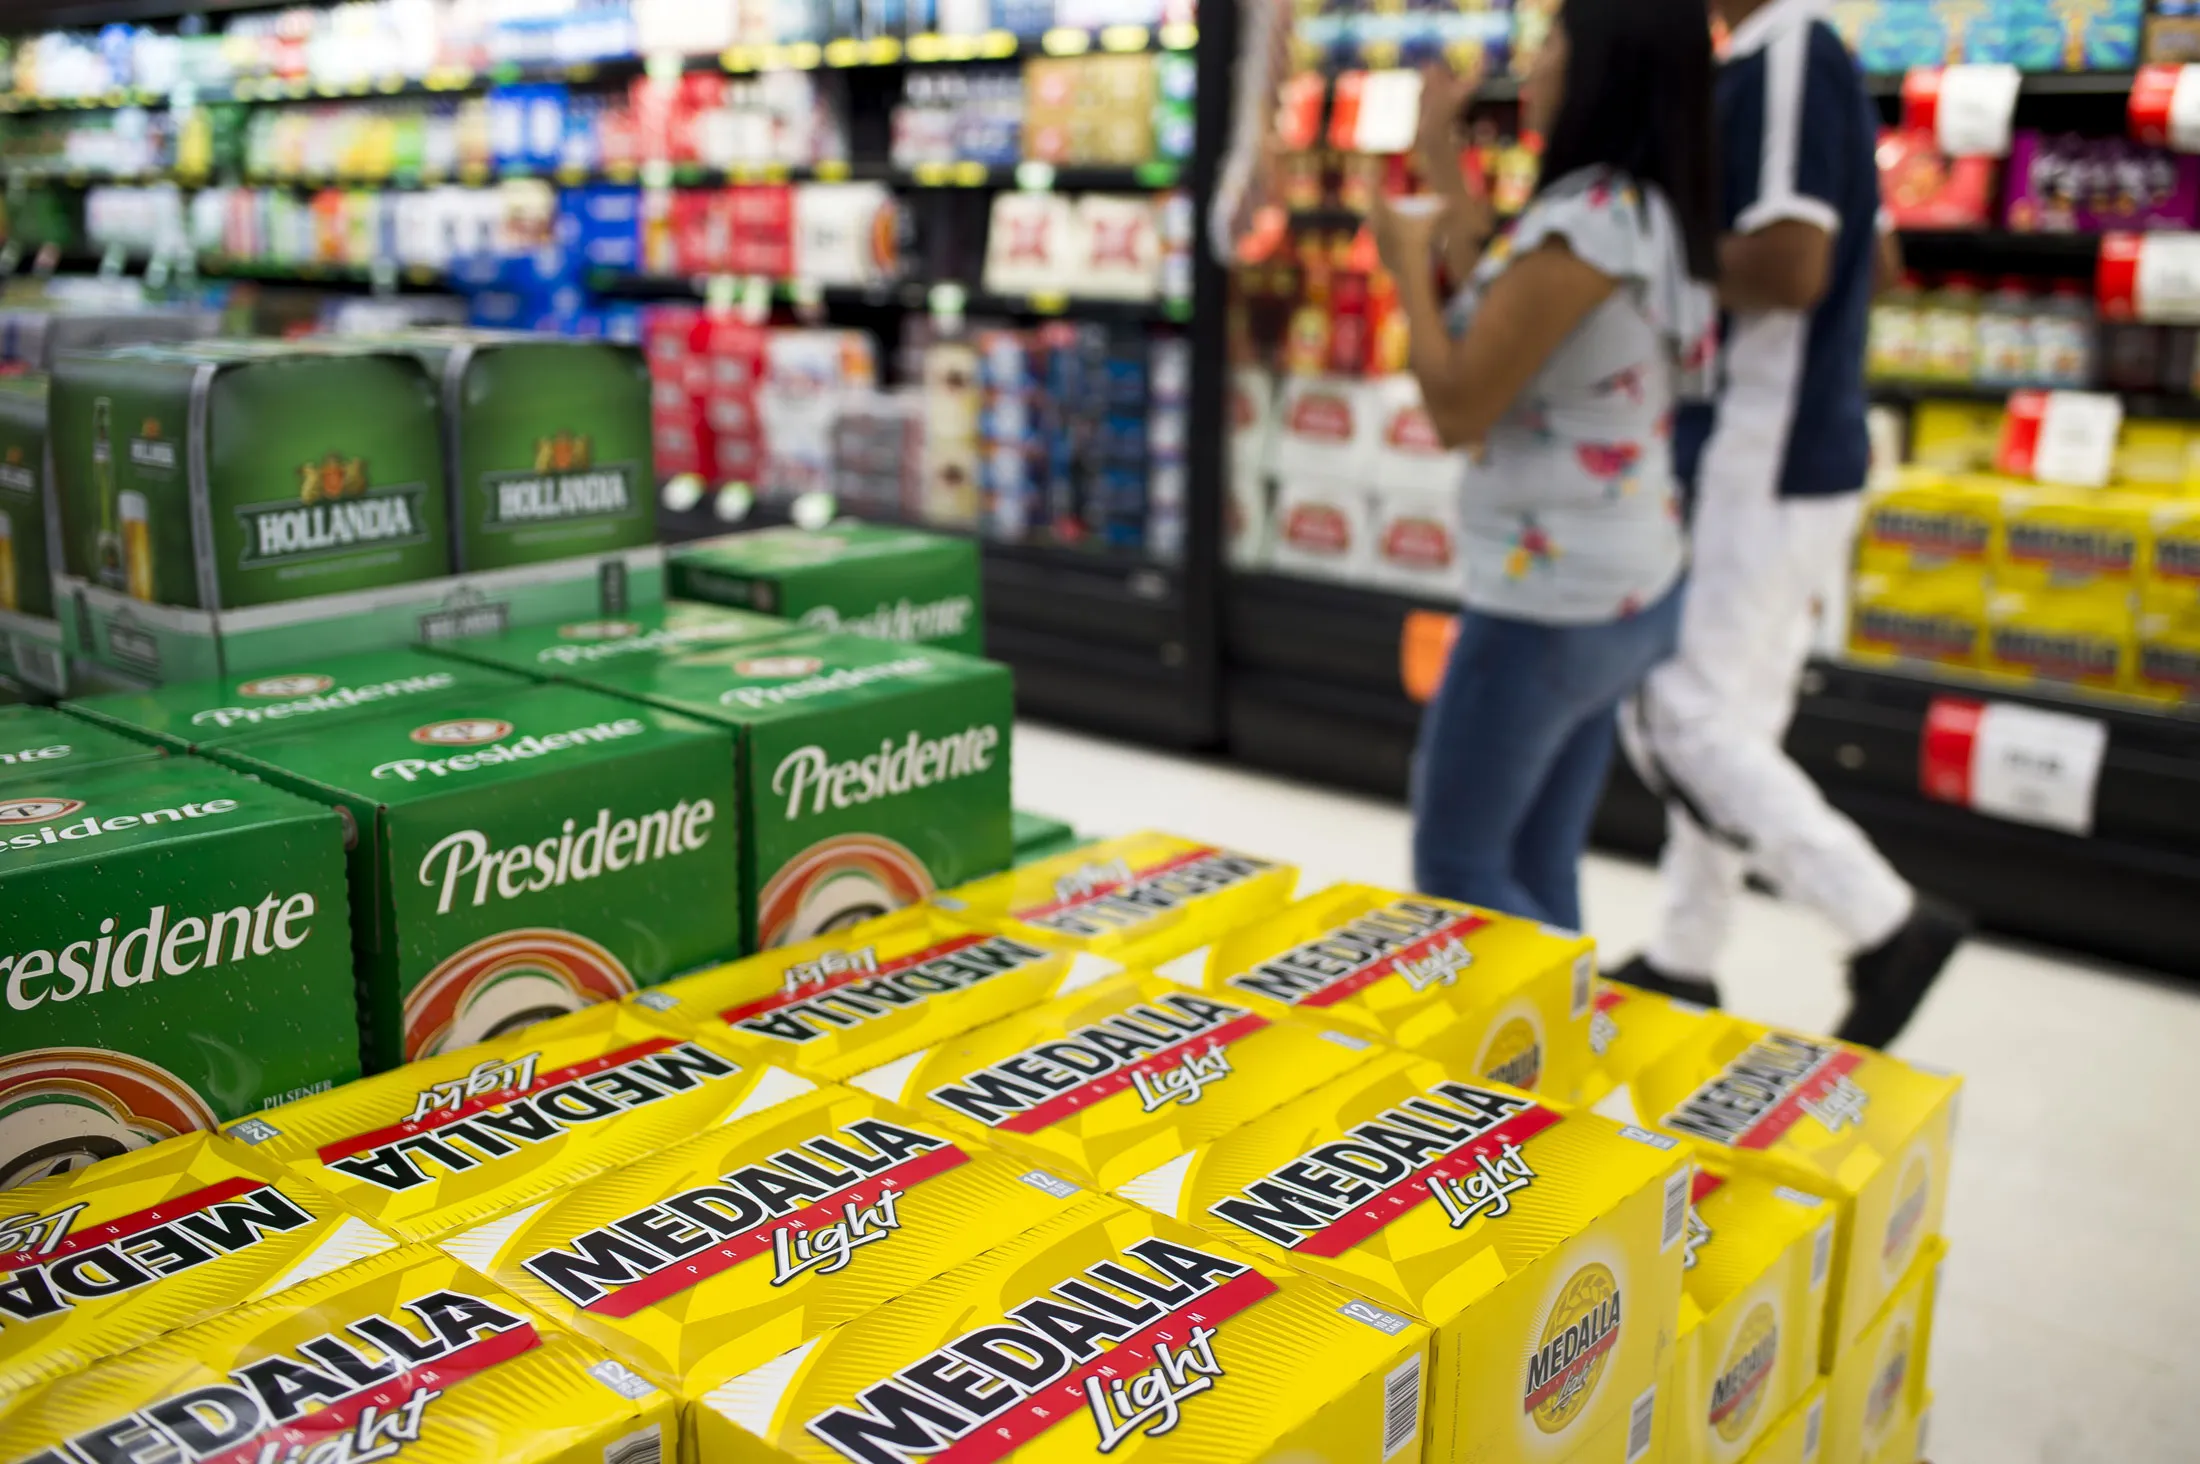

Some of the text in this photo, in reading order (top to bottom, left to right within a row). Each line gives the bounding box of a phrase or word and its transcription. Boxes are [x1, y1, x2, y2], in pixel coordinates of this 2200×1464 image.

[258, 496, 413, 555] HOLLANDIA
[192, 673, 456, 728] Presidente
[372, 718, 645, 782] Presidente
[772, 724, 998, 819] Presidente
[0, 799, 238, 851] sidente
[419, 798, 715, 915] Presidente
[730, 934, 1054, 1046] MEDALLA
[1225, 898, 1472, 1007] MEDALLA
[263, 1079, 333, 1111] PILSENER
[402, 1051, 541, 1126] Light
[925, 992, 1252, 1128] MEDALLA
[1130, 1043, 1233, 1113] Light
[244, 1124, 278, 1141] 12
[323, 1040, 744, 1193] MEDALLA
[1023, 1172, 1058, 1189] 12
[1206, 1079, 1538, 1250] MEDALLA
[1365, 1133, 1512, 1219] PREMIUM
[1425, 1142, 1538, 1229] Light
[520, 1116, 954, 1309] MEDALLA
[686, 1177, 898, 1274] PREMIUM
[769, 1187, 905, 1288] Light
[803, 1235, 1254, 1464] MEDALLA
[1343, 1303, 1383, 1322] 12
[1525, 1288, 1622, 1398] MEDALLA
[594, 1360, 635, 1384] 12
[995, 1310, 1208, 1440] PREMIUM
[1082, 1323, 1226, 1455] Light
